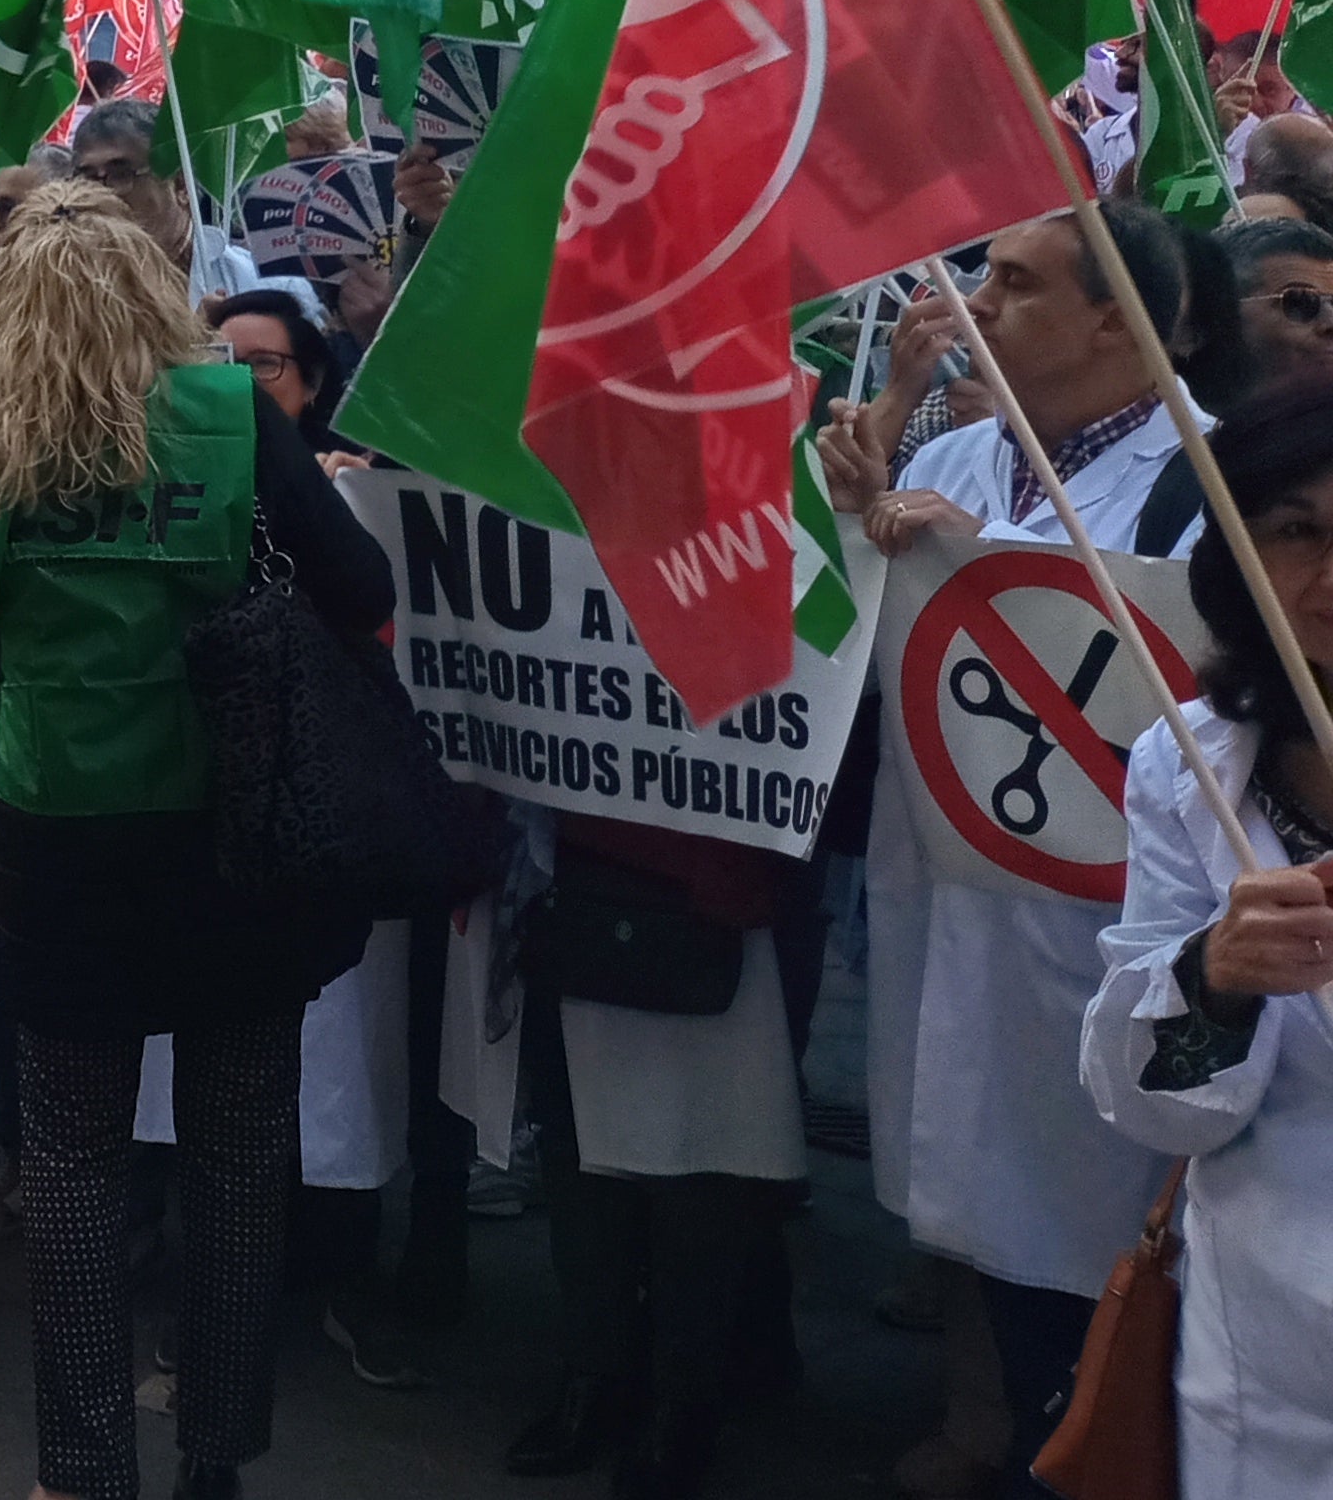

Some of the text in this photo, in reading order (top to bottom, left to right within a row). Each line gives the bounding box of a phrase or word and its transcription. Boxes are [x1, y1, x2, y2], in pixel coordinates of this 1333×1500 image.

[263, 206, 325, 224] por lo
[397, 488, 614, 644] NO A
[409, 637, 634, 723] RECORTES
[415, 708, 622, 798] SERVICIOS
